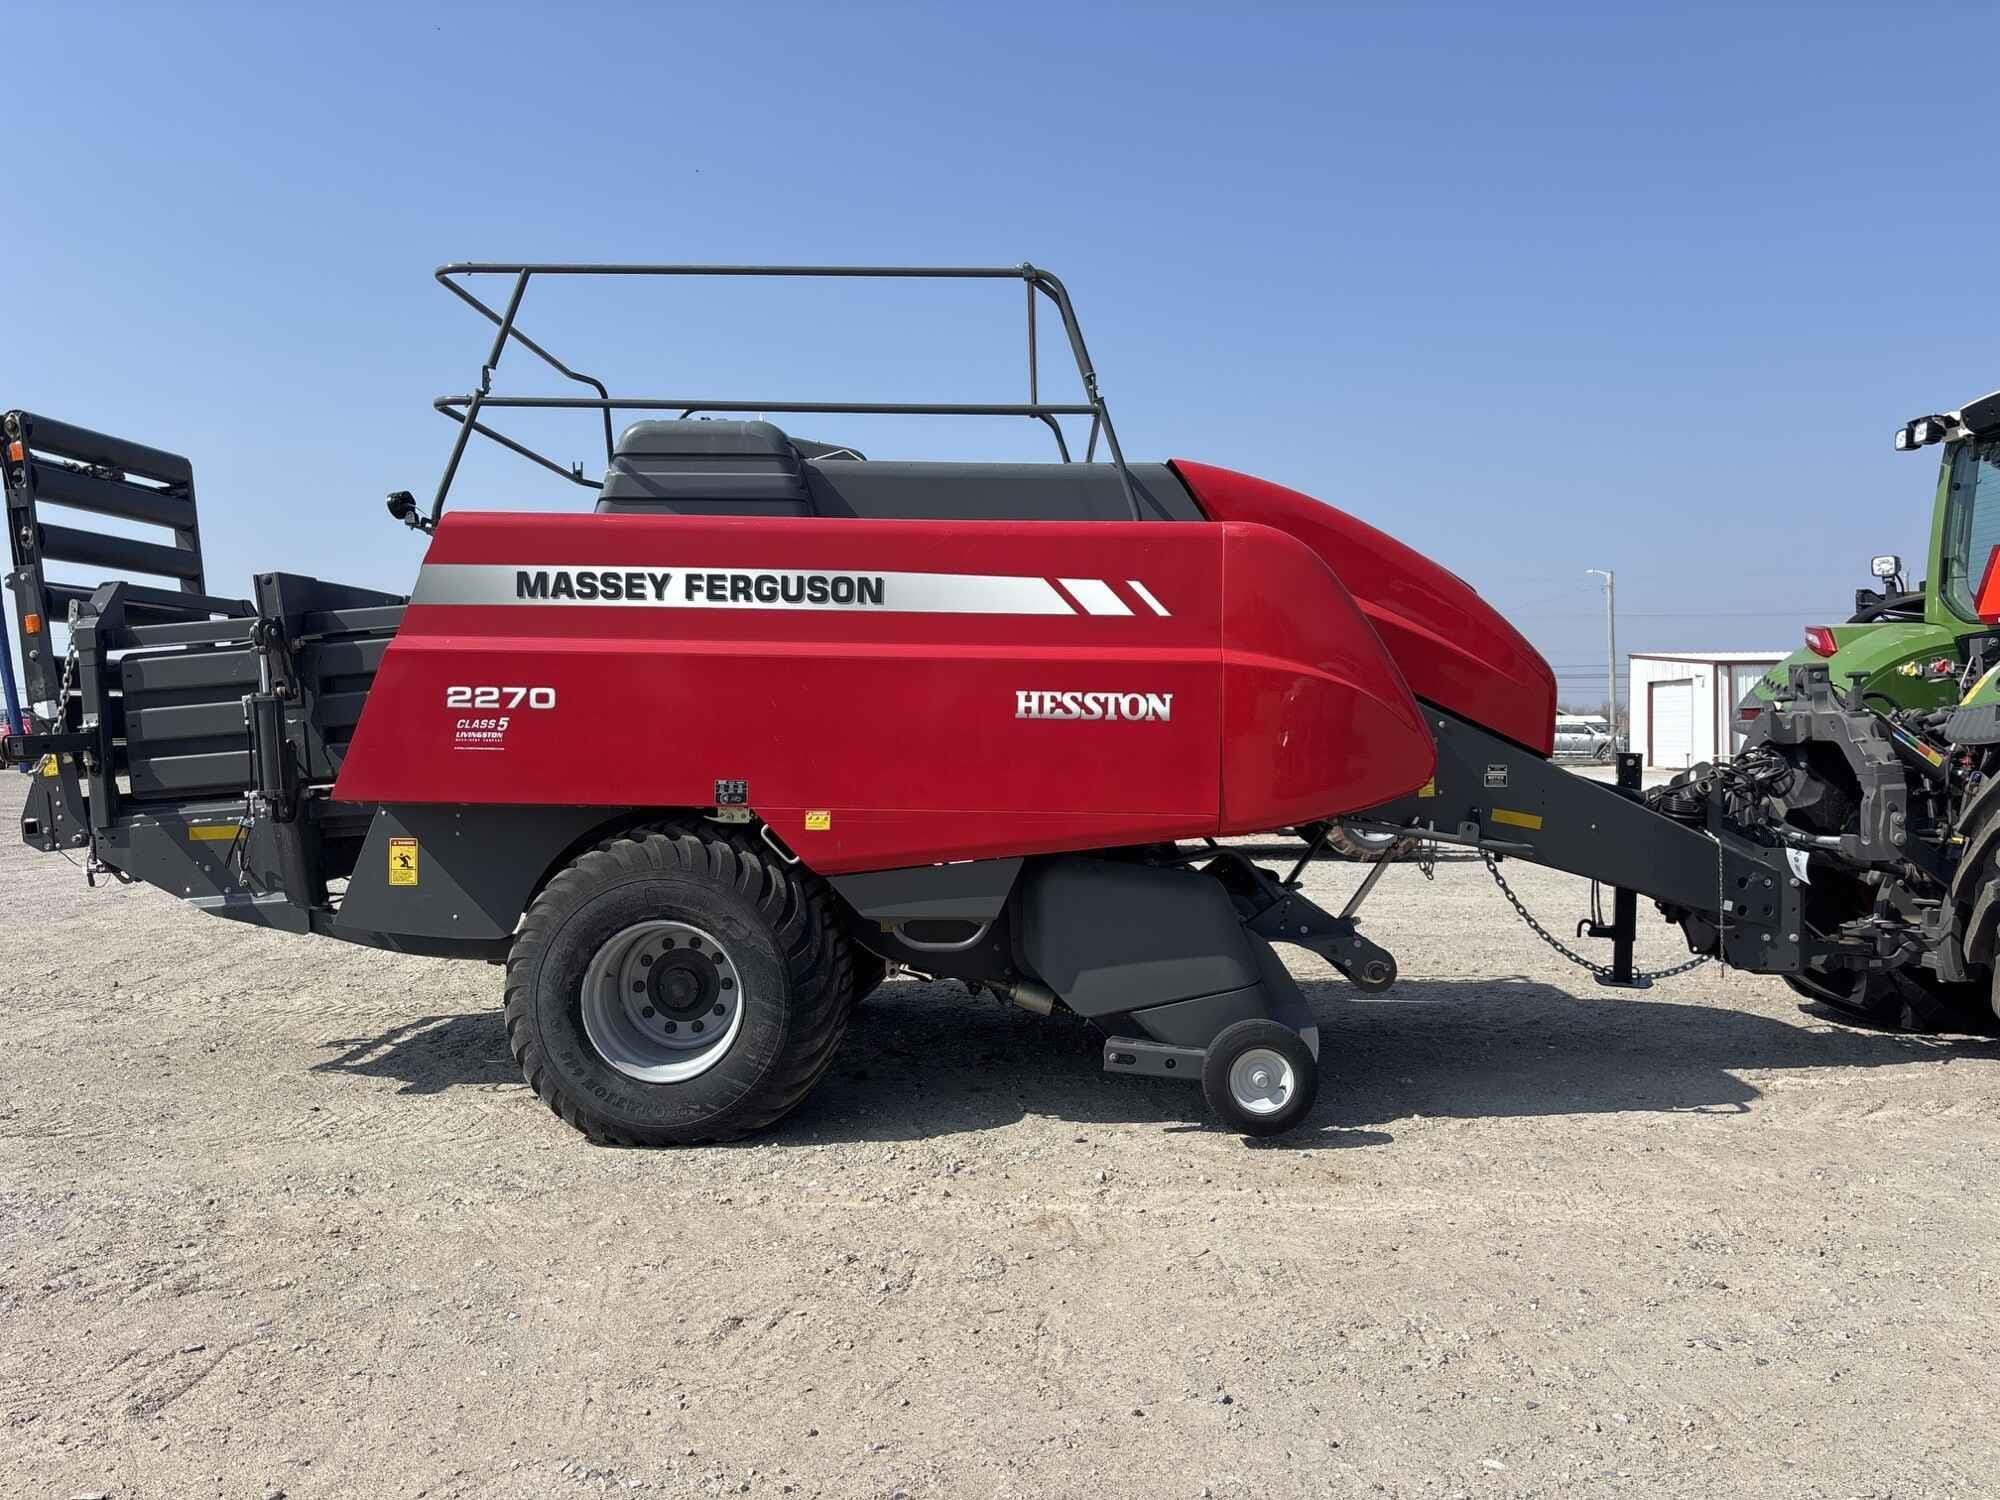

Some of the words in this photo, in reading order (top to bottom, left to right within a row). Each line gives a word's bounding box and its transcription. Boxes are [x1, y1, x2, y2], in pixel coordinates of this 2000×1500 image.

[516, 571, 671, 600] MASSEY
[684, 574, 884, 605] FERGUSON
[447, 686, 556, 709] 2270
[1015, 690, 1174, 721] HESSTON
[456, 719, 496, 729] CLASS
[497, 717, 510, 731] 5
